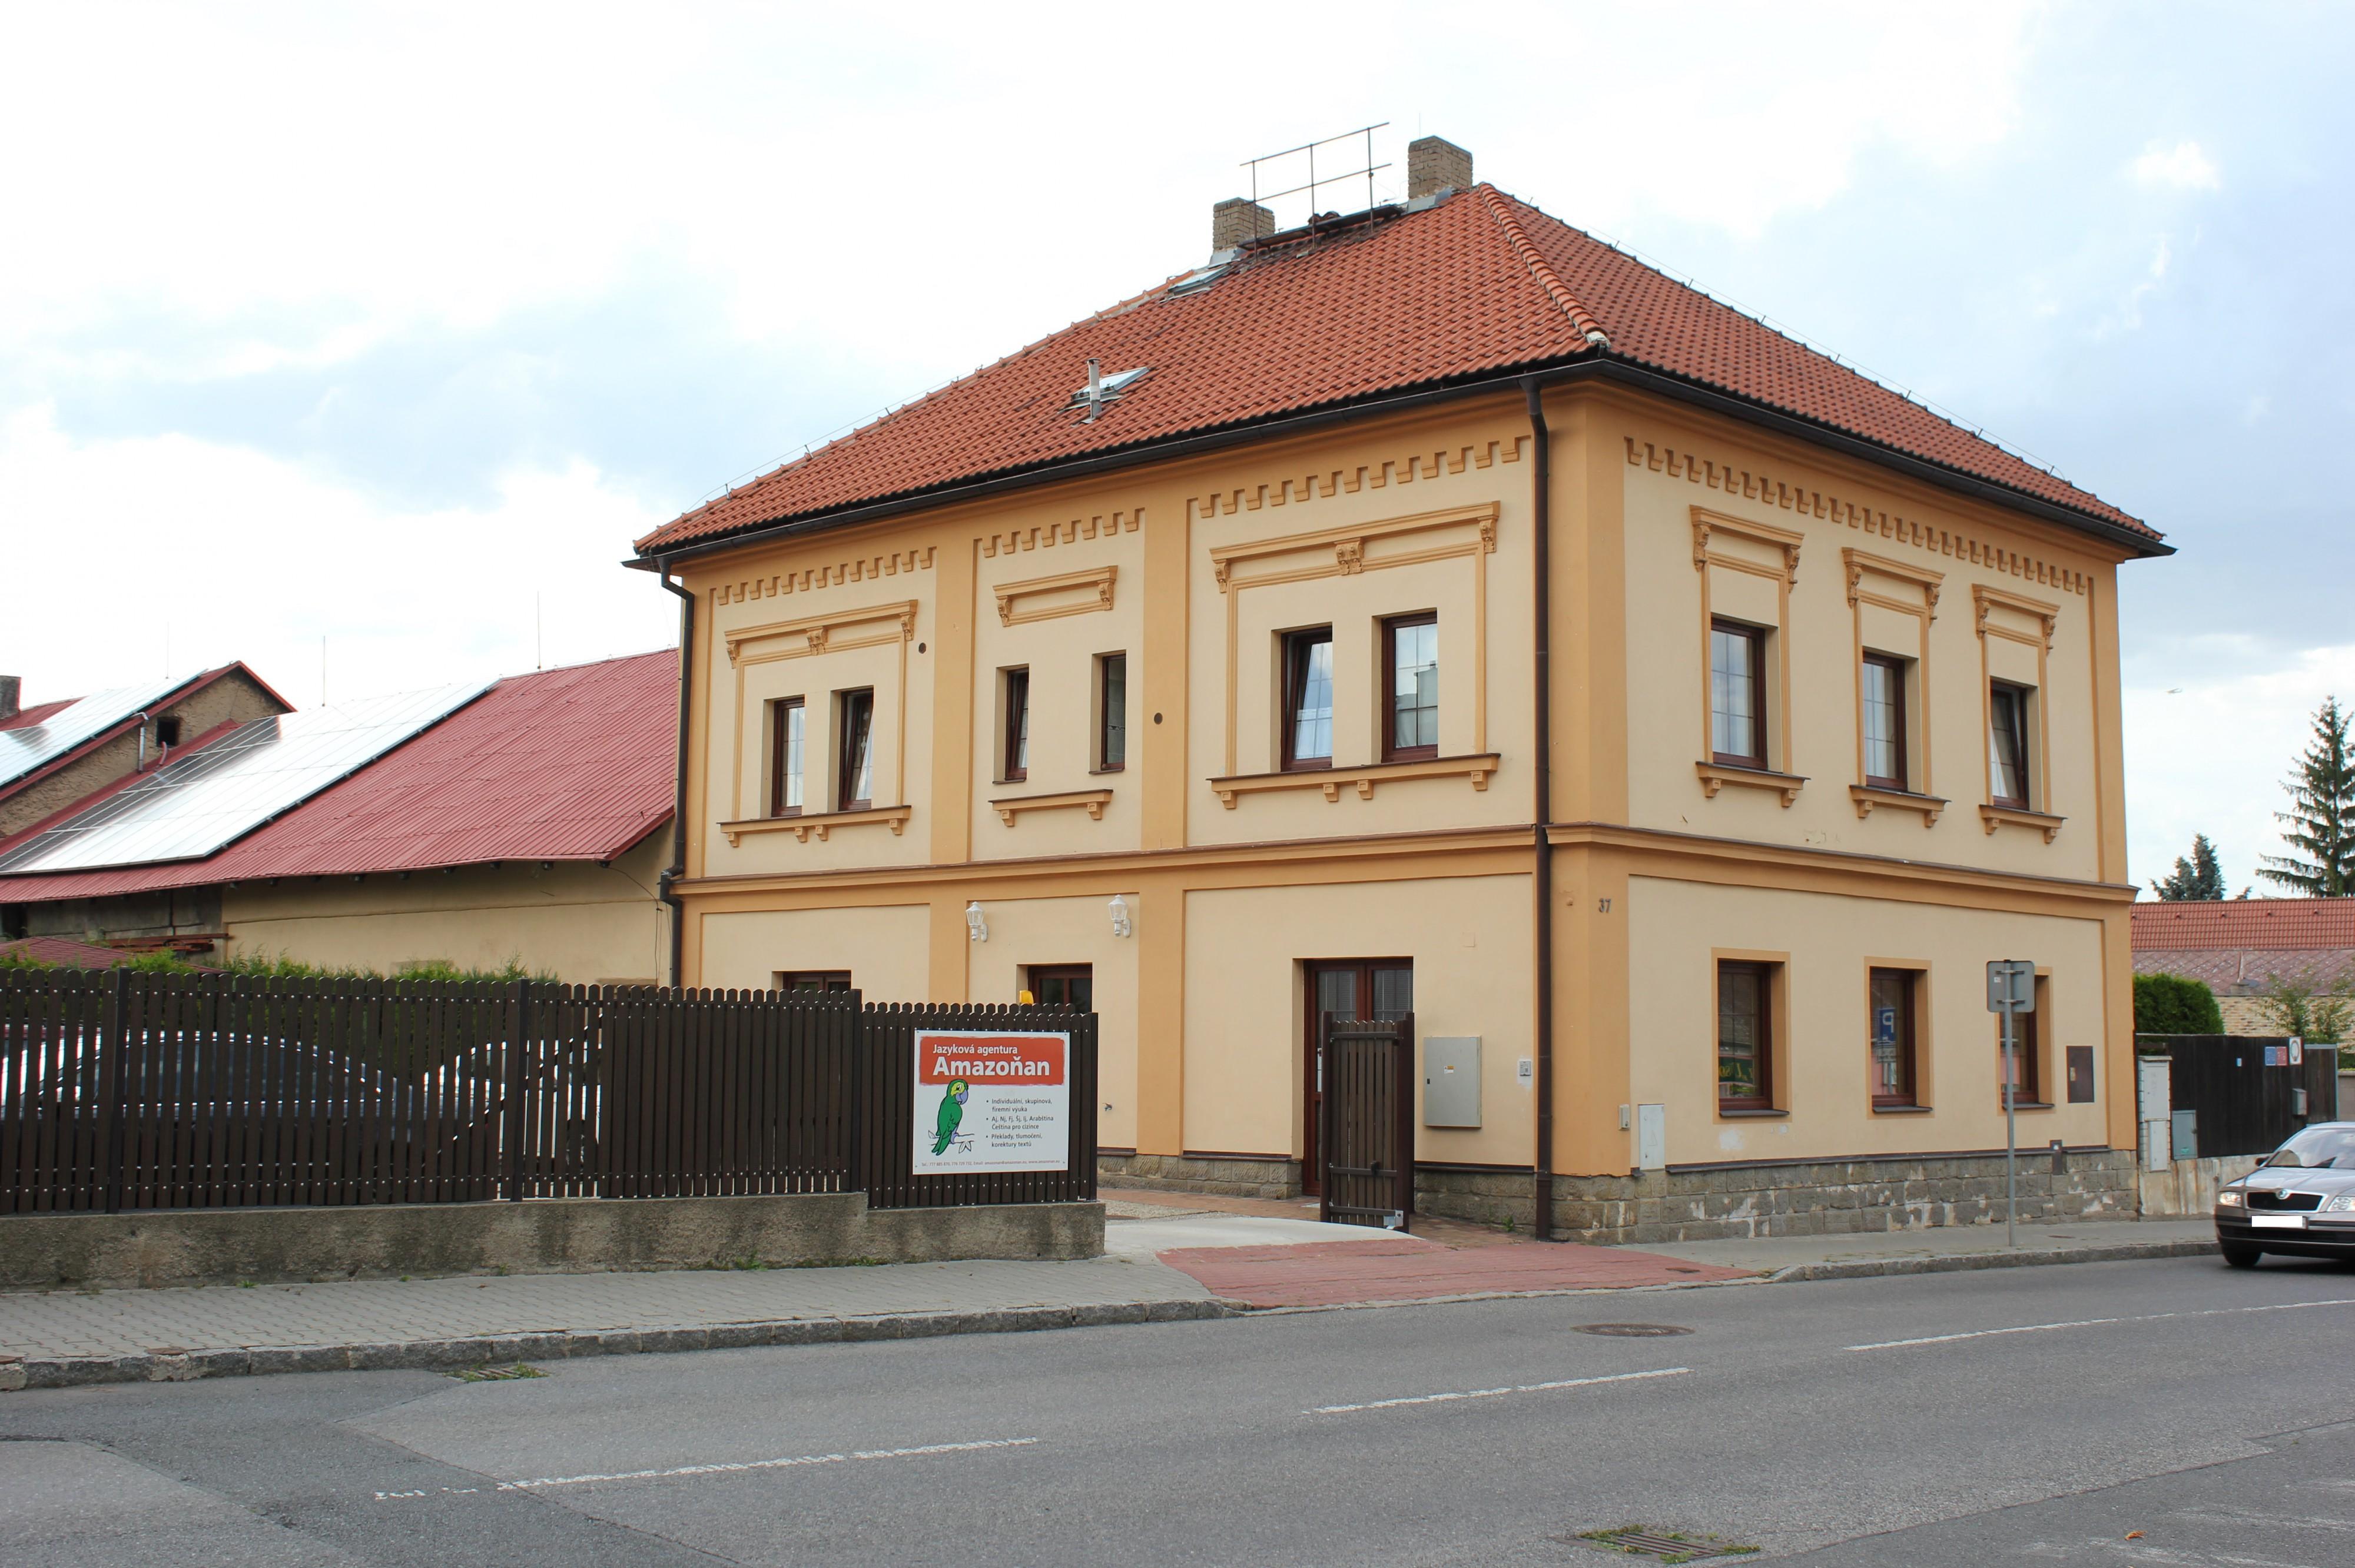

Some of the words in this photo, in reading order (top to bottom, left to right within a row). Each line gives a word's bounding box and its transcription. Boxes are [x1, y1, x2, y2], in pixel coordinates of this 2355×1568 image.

[1598, 898, 1611, 913] 37
[933, 1044, 974, 1056] Jazyková
[977, 1045, 1017, 1056] agentura
[933, 1056, 1050, 1076] Amazoňan
